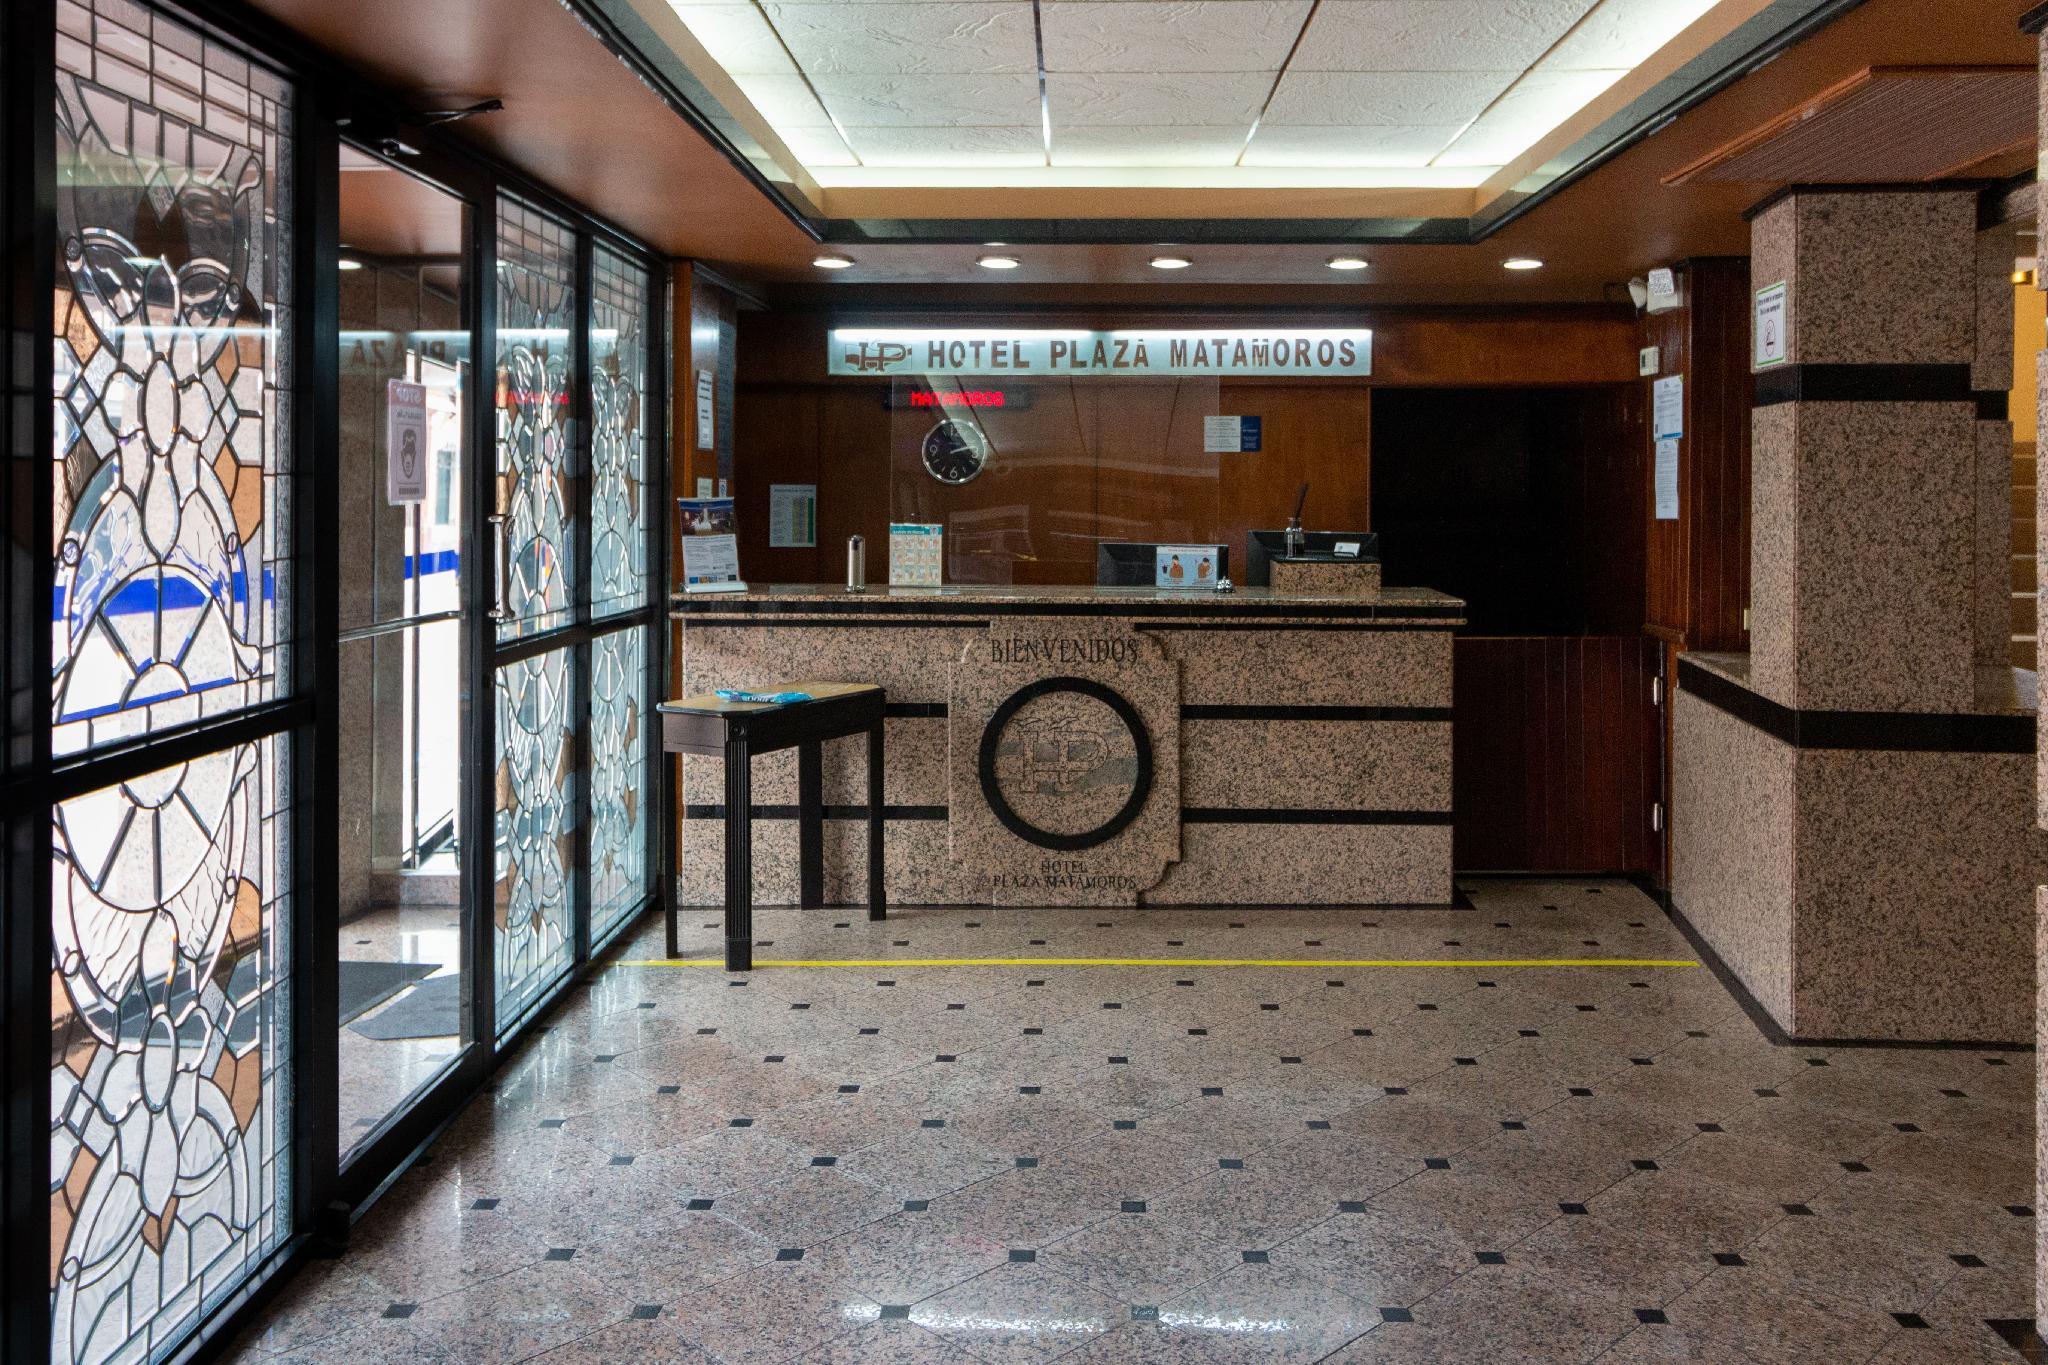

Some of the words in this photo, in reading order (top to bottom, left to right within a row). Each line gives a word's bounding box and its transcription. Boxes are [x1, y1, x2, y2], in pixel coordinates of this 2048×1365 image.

[927, 340, 1030, 369] HOTEL
[1050, 339, 1149, 368] PLAZA
[1170, 338, 1356, 368] MATAMOROS
[911, 391, 1005, 407] MATAMOROS
[929, 444, 938, 457] 9
[949, 466, 958, 479] 6
[991, 637, 1138, 664] BIENVENIDOS
[1040, 860, 1088, 874] HOTEL
[993, 874, 1040, 888] PLAZA
[1044, 874, 1137, 889] MATAMOROS
